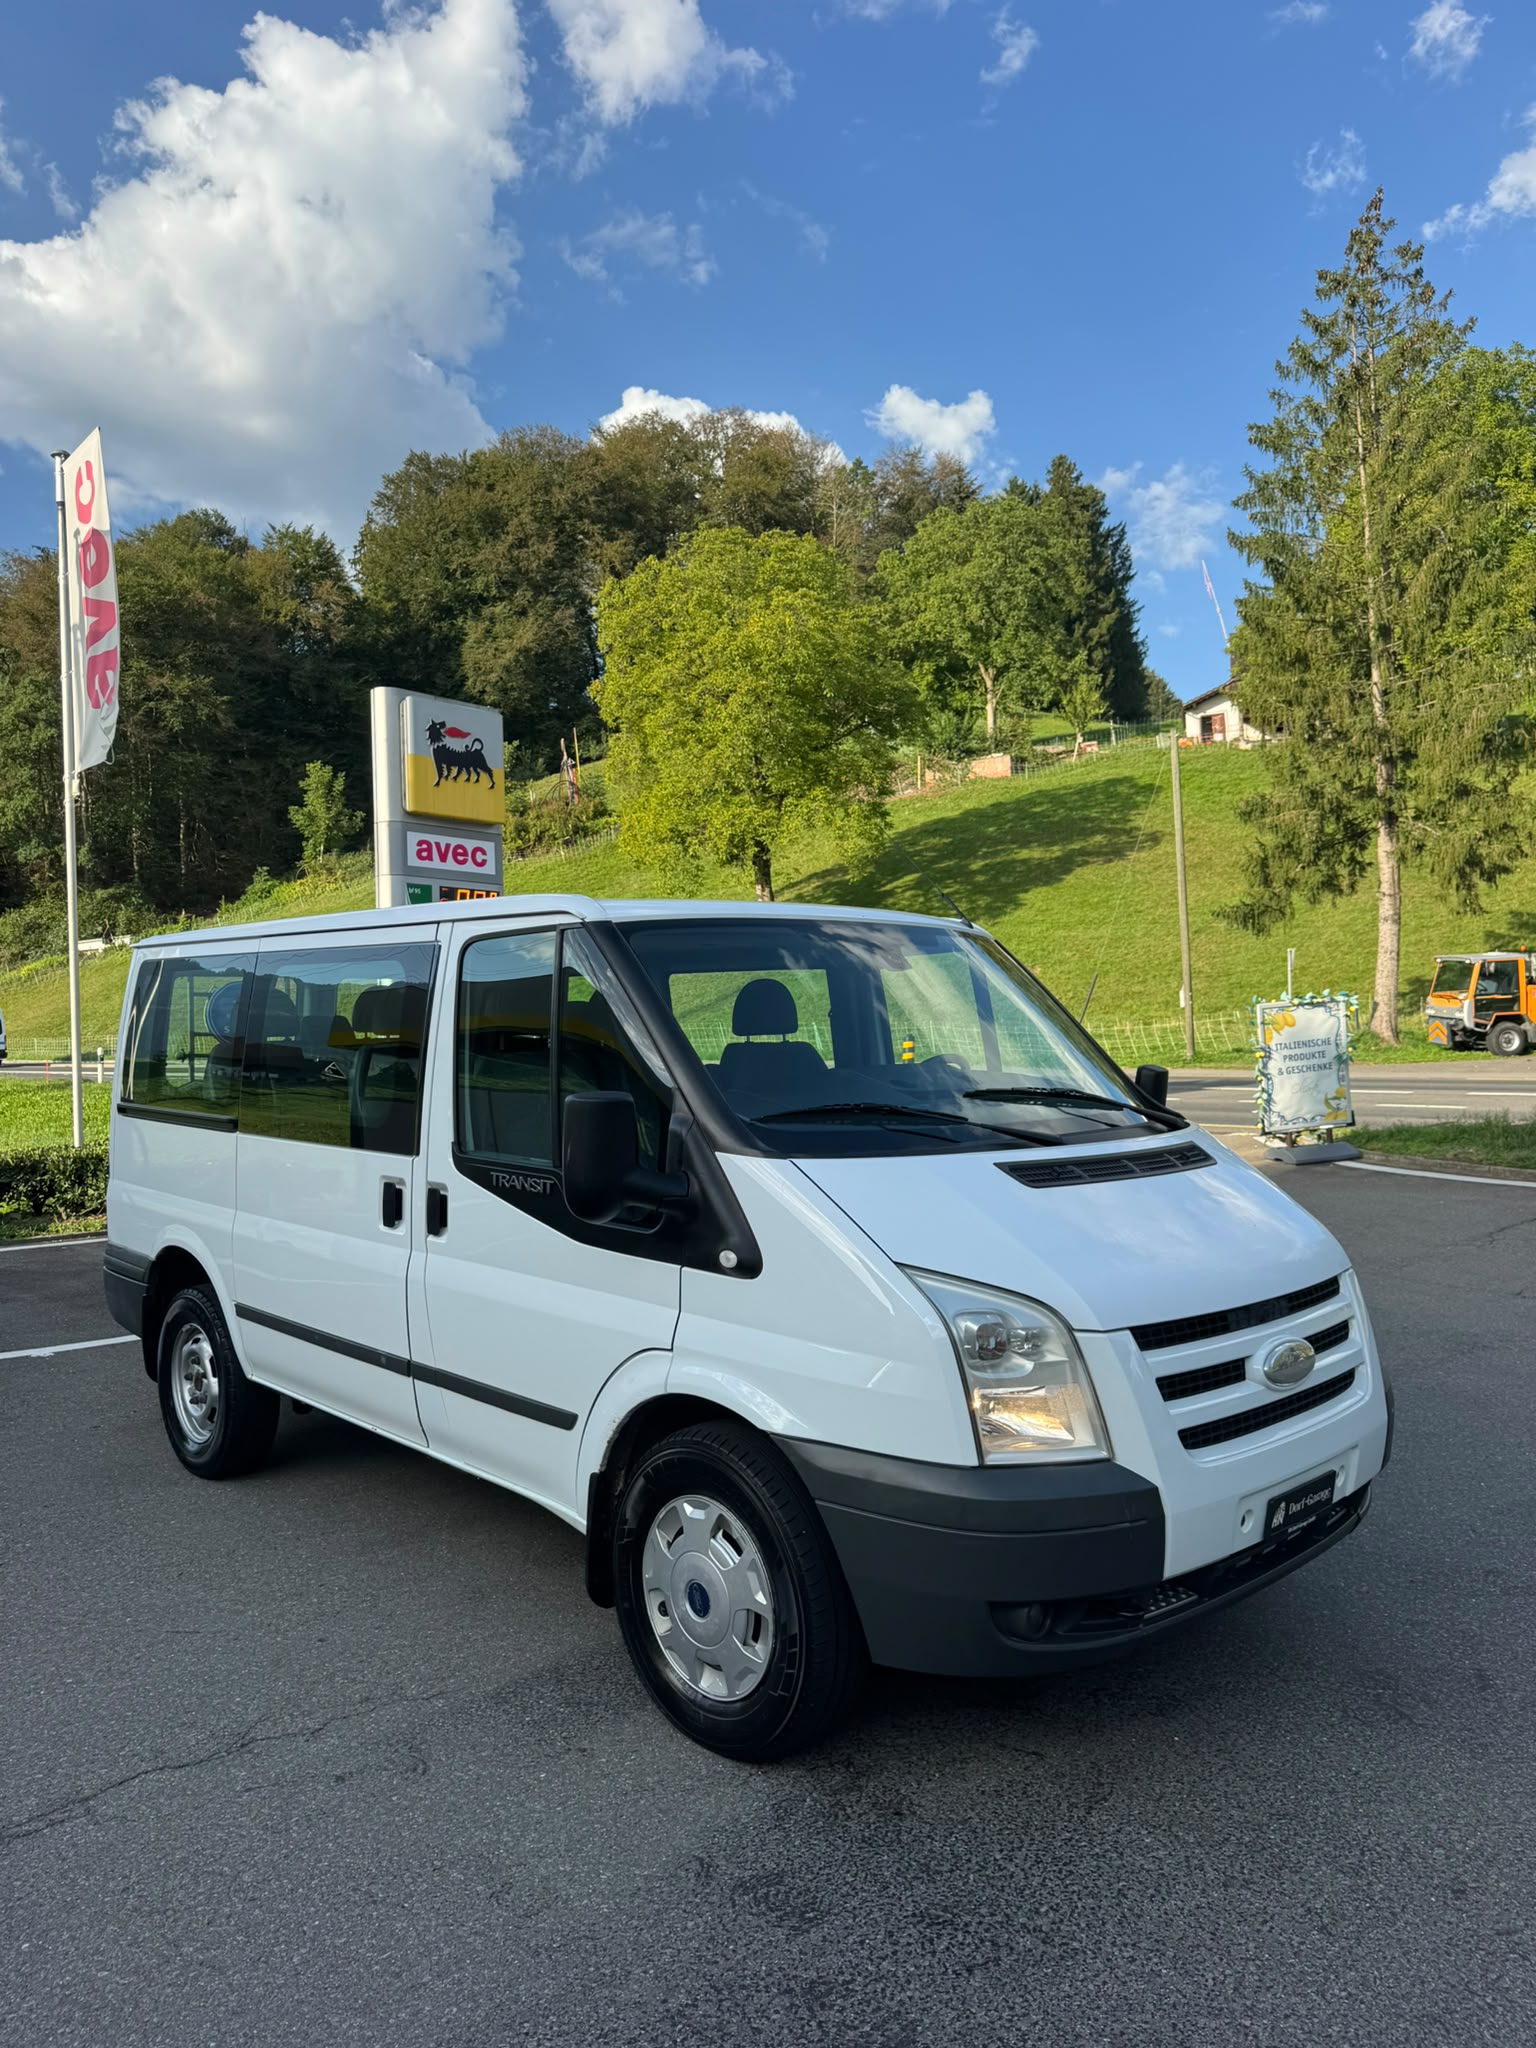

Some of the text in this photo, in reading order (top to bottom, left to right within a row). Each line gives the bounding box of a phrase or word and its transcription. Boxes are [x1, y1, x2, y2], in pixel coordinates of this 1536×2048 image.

[75, 460, 118, 709] avec
[416, 839, 488, 868] avec
[1275, 1037, 1332, 1051] ITALIENISCHE
[1283, 1050, 1327, 1063] PRODUKTE
[1277, 1062, 1334, 1076] & GESCHENKE
[490, 1171, 554, 1195] TRANSIT
